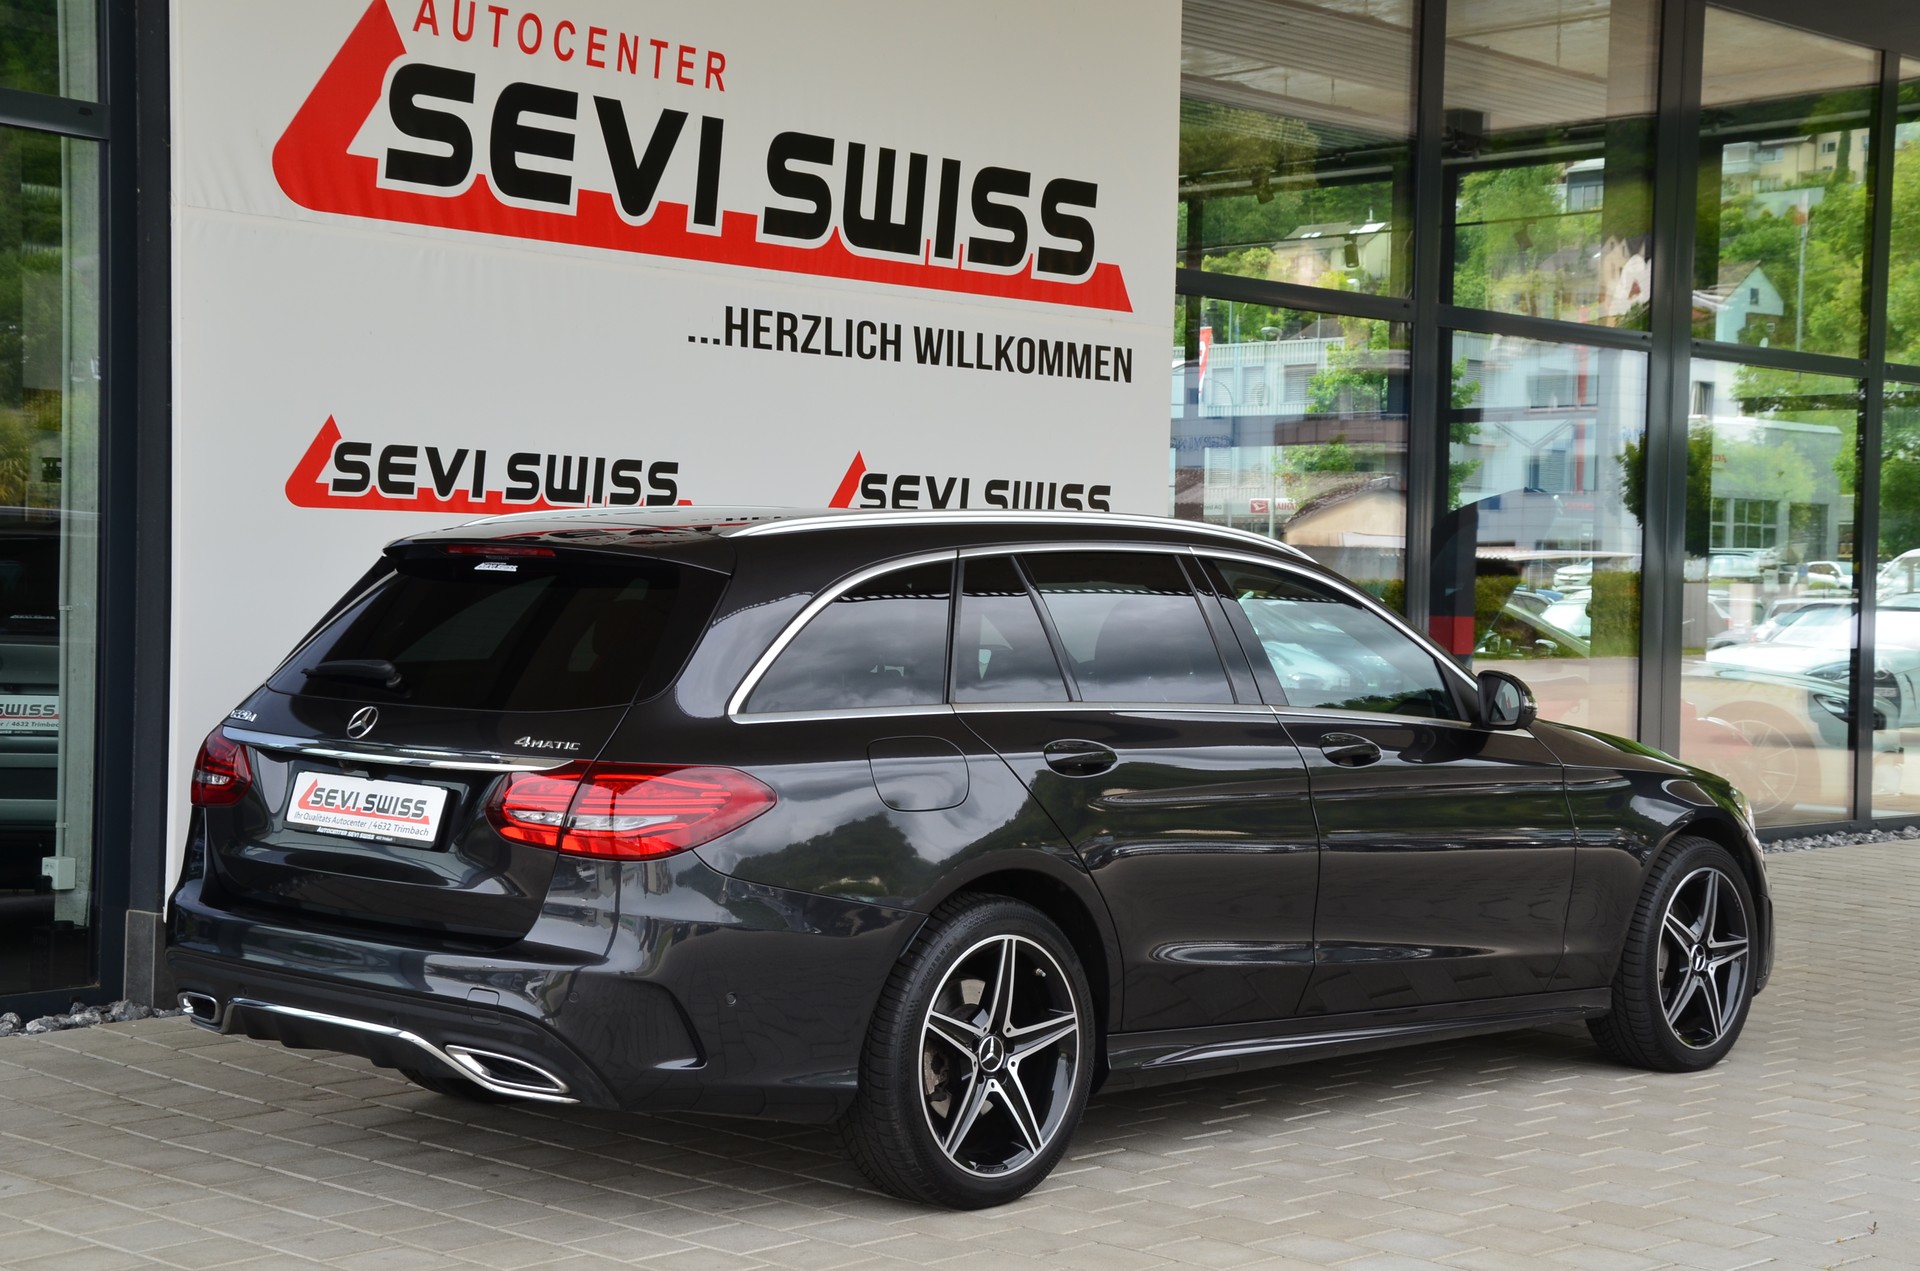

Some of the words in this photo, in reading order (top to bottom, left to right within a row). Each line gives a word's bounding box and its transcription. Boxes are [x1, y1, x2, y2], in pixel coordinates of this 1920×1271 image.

[412, 0, 726, 92] AUTOCENTER
[385, 63, 725, 227] SEVI
[763, 131, 1099, 276] SWISS
[913, 325, 1133, 384] WILLKOMMEN
[331, 441, 487, 499] SEVI
[505, 452, 680, 506] SWISS
[860, 473, 970, 510] SEVI
[514, 736, 581, 751] 4MATIC
[311, 787, 360, 810] SEVI
[362, 793, 427, 818] SWISS
[331, 816, 367, 828] Autocenter
[373, 821, 392, 832] 4632
[393, 825, 430, 837] Trimbach
